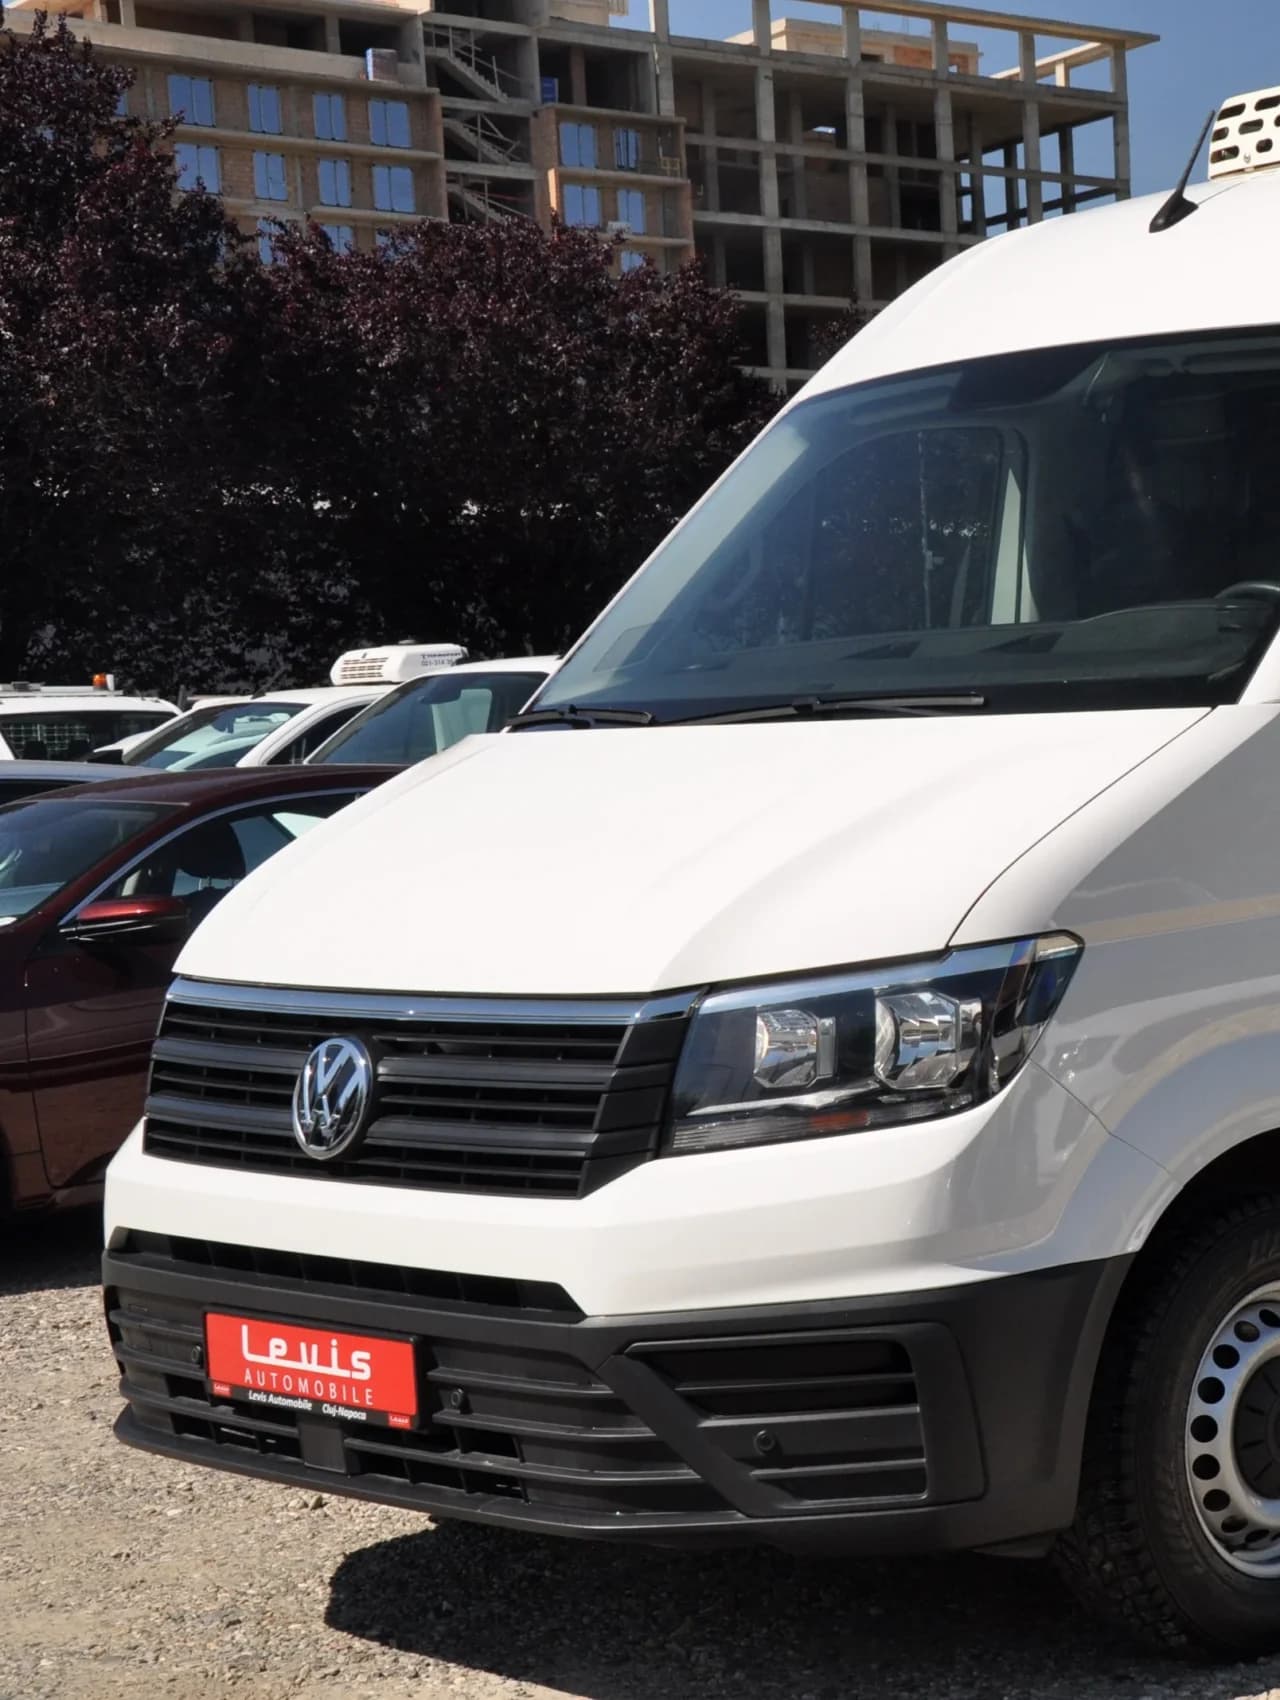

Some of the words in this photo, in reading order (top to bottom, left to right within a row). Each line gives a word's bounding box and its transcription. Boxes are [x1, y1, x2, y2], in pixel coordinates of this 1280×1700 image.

[241, 1324, 371, 1380] Levis
[244, 1368, 373, 1405] AUTOMOBILE
[248, 1390, 267, 1402] Levis
[268, 1394, 312, 1411] Automobile
[322, 1403, 367, 1420] Cluj-Napoca
